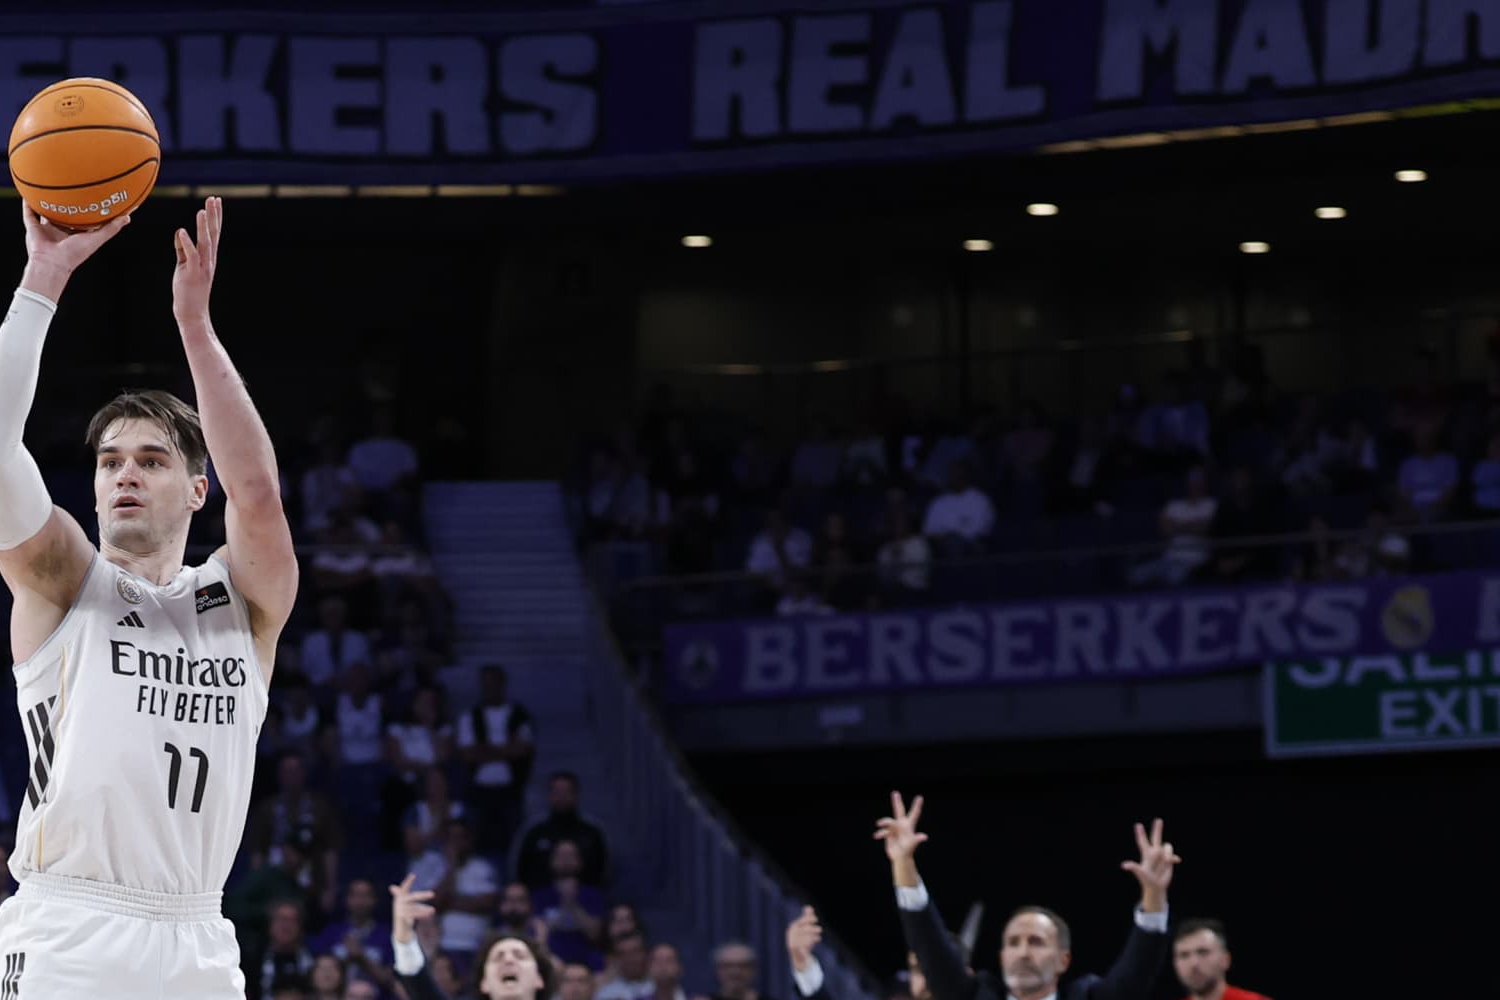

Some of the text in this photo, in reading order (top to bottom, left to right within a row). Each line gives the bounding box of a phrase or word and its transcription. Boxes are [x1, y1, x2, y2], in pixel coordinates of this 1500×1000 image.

[692, 0, 1046, 140] REAL
[40, 200, 99, 215] endesa
[741, 587, 1368, 693] BERSERKERS
[137, 685, 169, 717] FLY
[164, 742, 209, 813] 11
